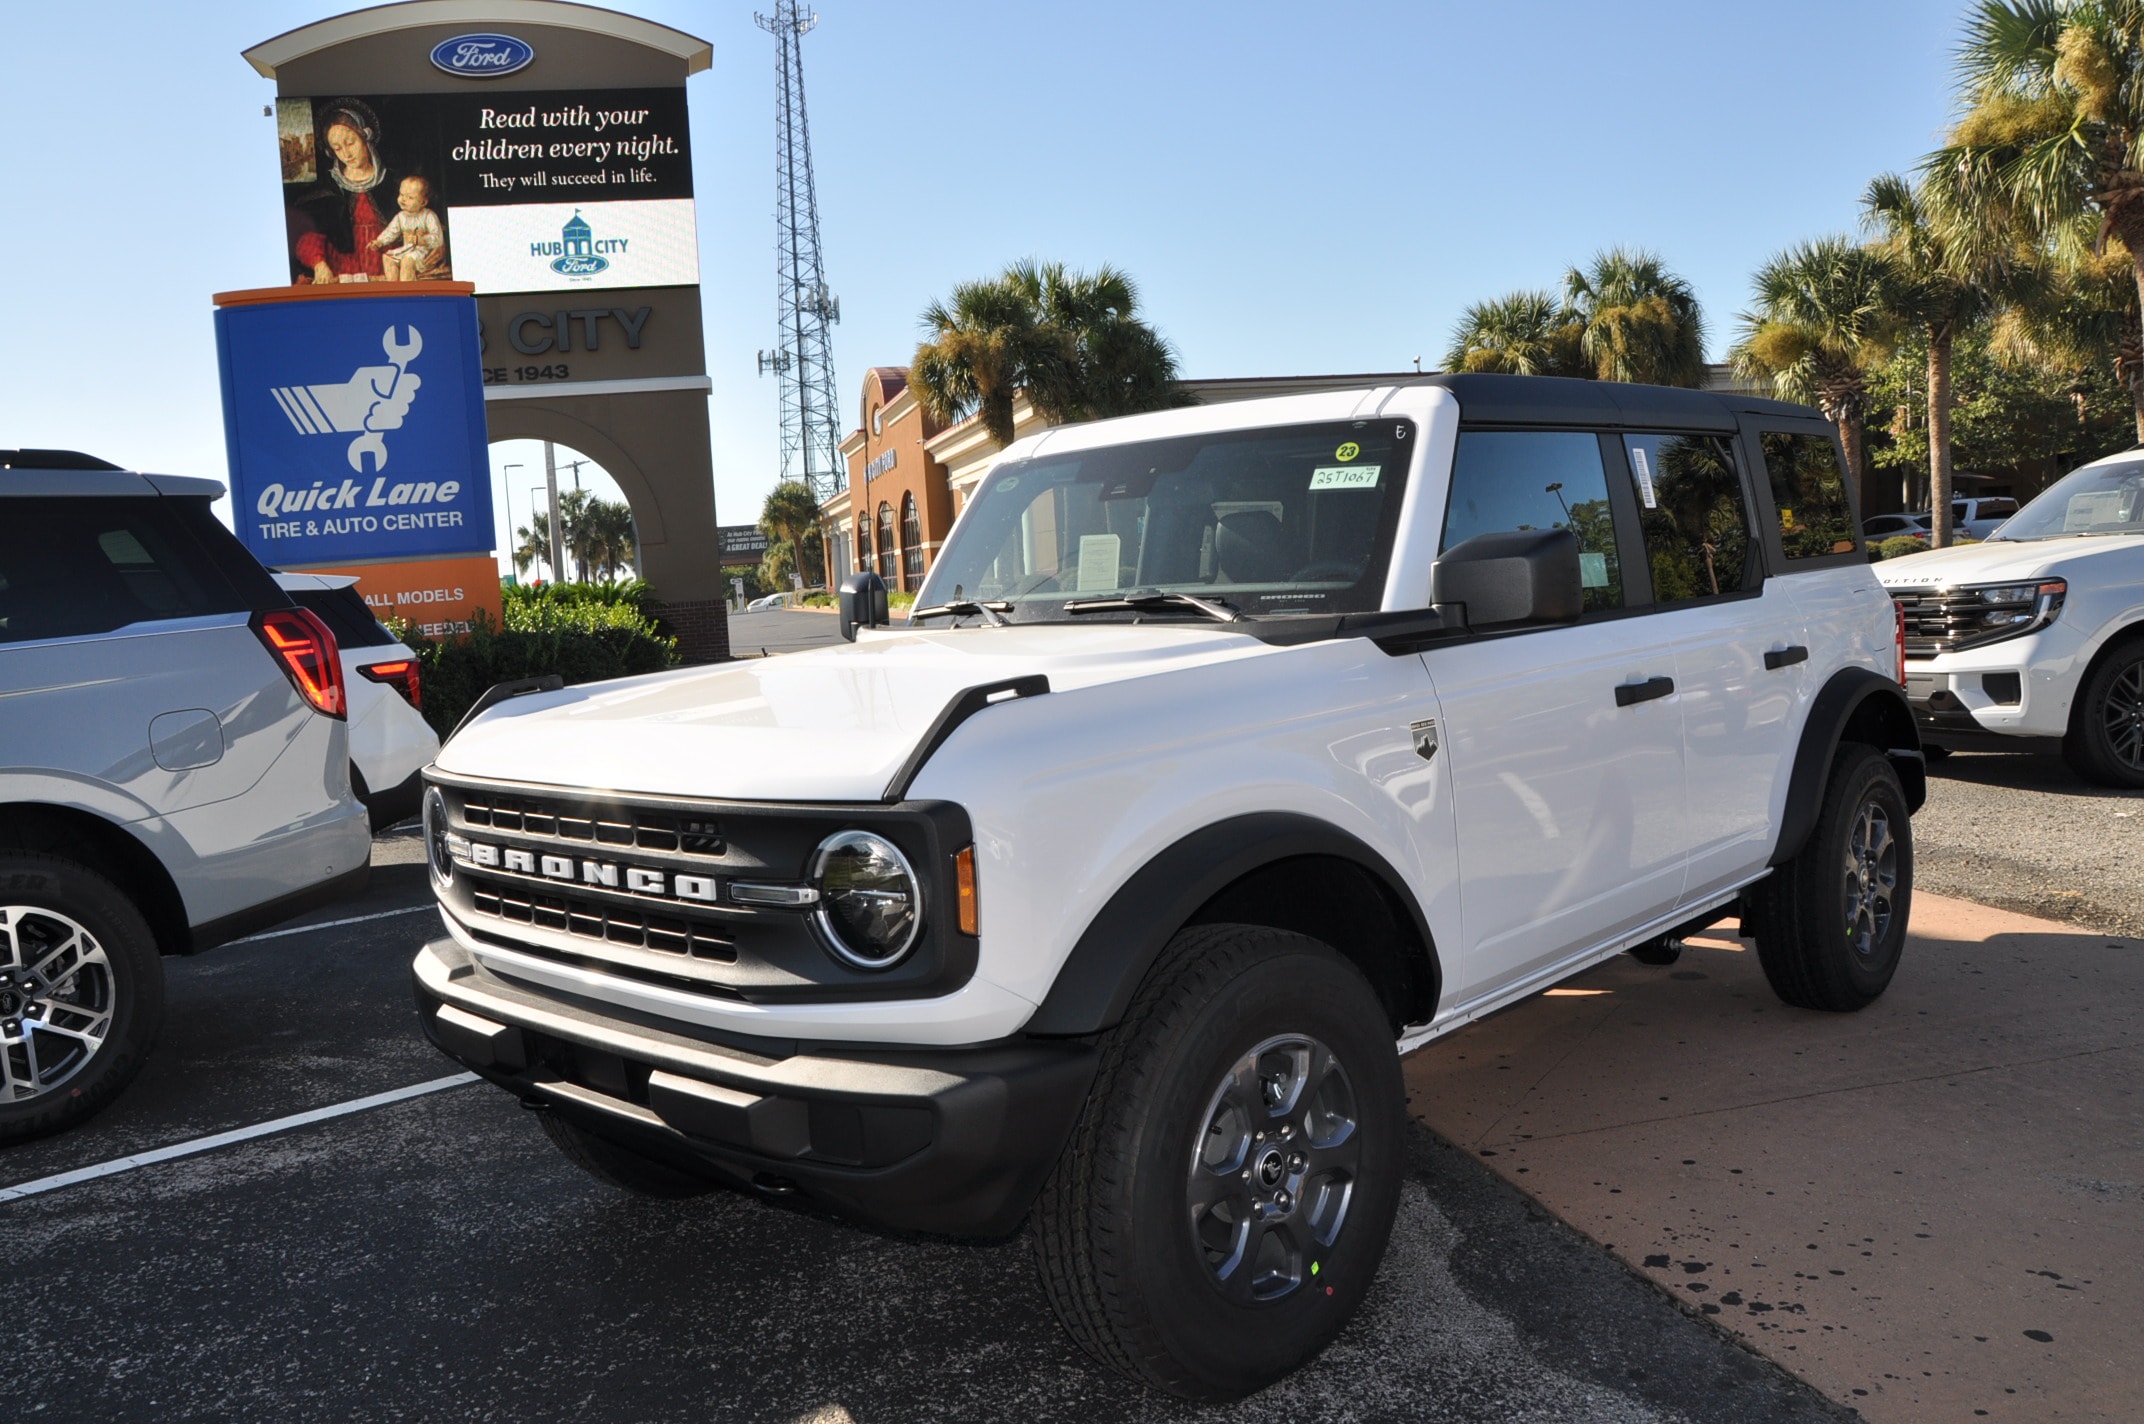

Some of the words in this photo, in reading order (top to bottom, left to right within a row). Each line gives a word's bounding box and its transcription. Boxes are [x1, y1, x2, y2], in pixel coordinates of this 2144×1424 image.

[452, 42, 511, 67] Ford
[479, 106, 536, 129] Read
[541, 105, 591, 127] with
[594, 109, 649, 132] your
[451, 138, 543, 161] children
[549, 142, 611, 163] every
[616, 134, 679, 162] night.
[479, 172, 516, 191] They
[520, 170, 547, 186] will
[551, 168, 606, 186] succeed
[611, 169, 626, 184] in
[630, 167, 657, 183] life.
[530, 241, 562, 257] HUB
[594, 238, 629, 254] CITY
[562, 257, 597, 272] Ford
[509, 306, 652, 355] CITY
[514, 364, 569, 381] 1943
[1338, 445, 1357, 457] 23
[1316, 470, 1375, 485] 25T1067
[256, 478, 363, 518] Quick
[365, 476, 460, 507] Lane
[259, 521, 302, 540] TIRE
[305, 520, 319, 536] &
[323, 516, 378, 535] AUTO
[382, 511, 463, 531] CENTER
[751, 542, 768, 550] DEAL!
[364, 593, 394, 607] ALL
[396, 587, 465, 605] MODELS
[471, 843, 717, 900] BRONCO
